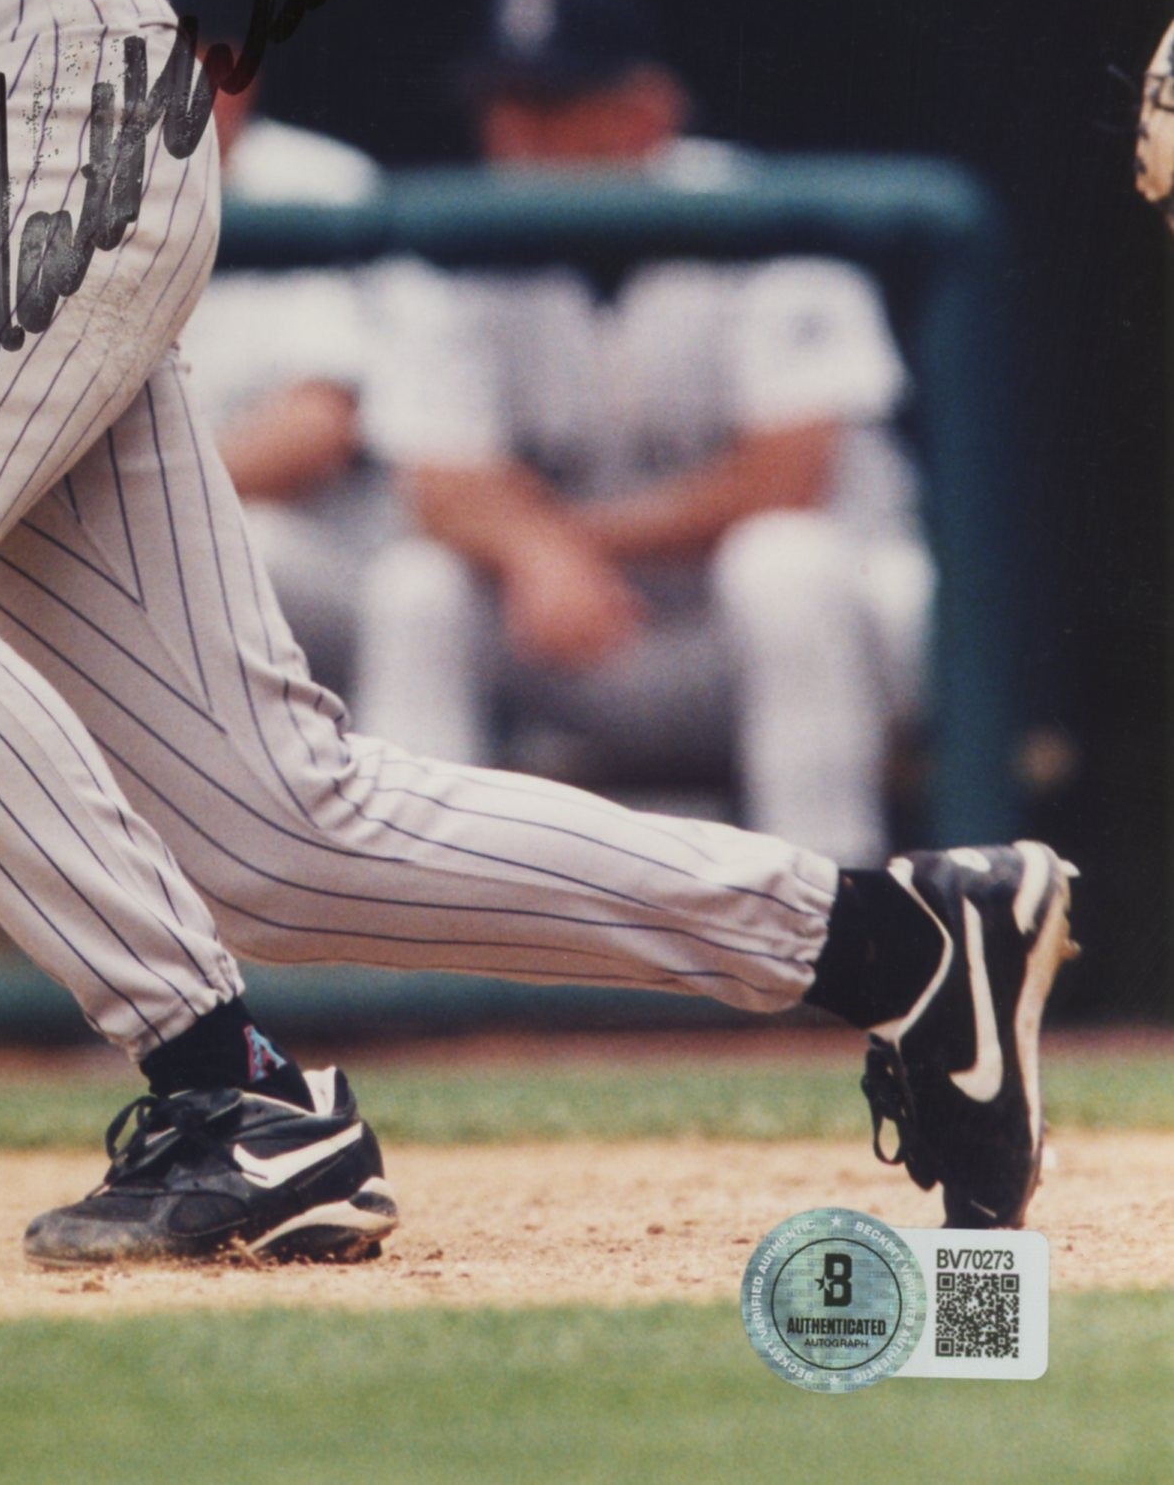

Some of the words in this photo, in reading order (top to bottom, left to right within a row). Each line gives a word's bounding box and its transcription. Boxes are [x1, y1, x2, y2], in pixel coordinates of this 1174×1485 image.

[758, 1219, 816, 1275] AUTHENTIC
[854, 1221, 906, 1262] BECKETT
[936, 1249, 1015, 1270] BV70273
[751, 1276, 768, 1339] VERIFIED
[900, 1261, 917, 1327] VERIFIED
[787, 1317, 887, 1337] AUTHENTICATED
[804, 1338, 869, 1349] AUTOGRAPH
[764, 1341, 815, 1382] BECKETT
[853, 1328, 911, 1384] AUTHENTIC
